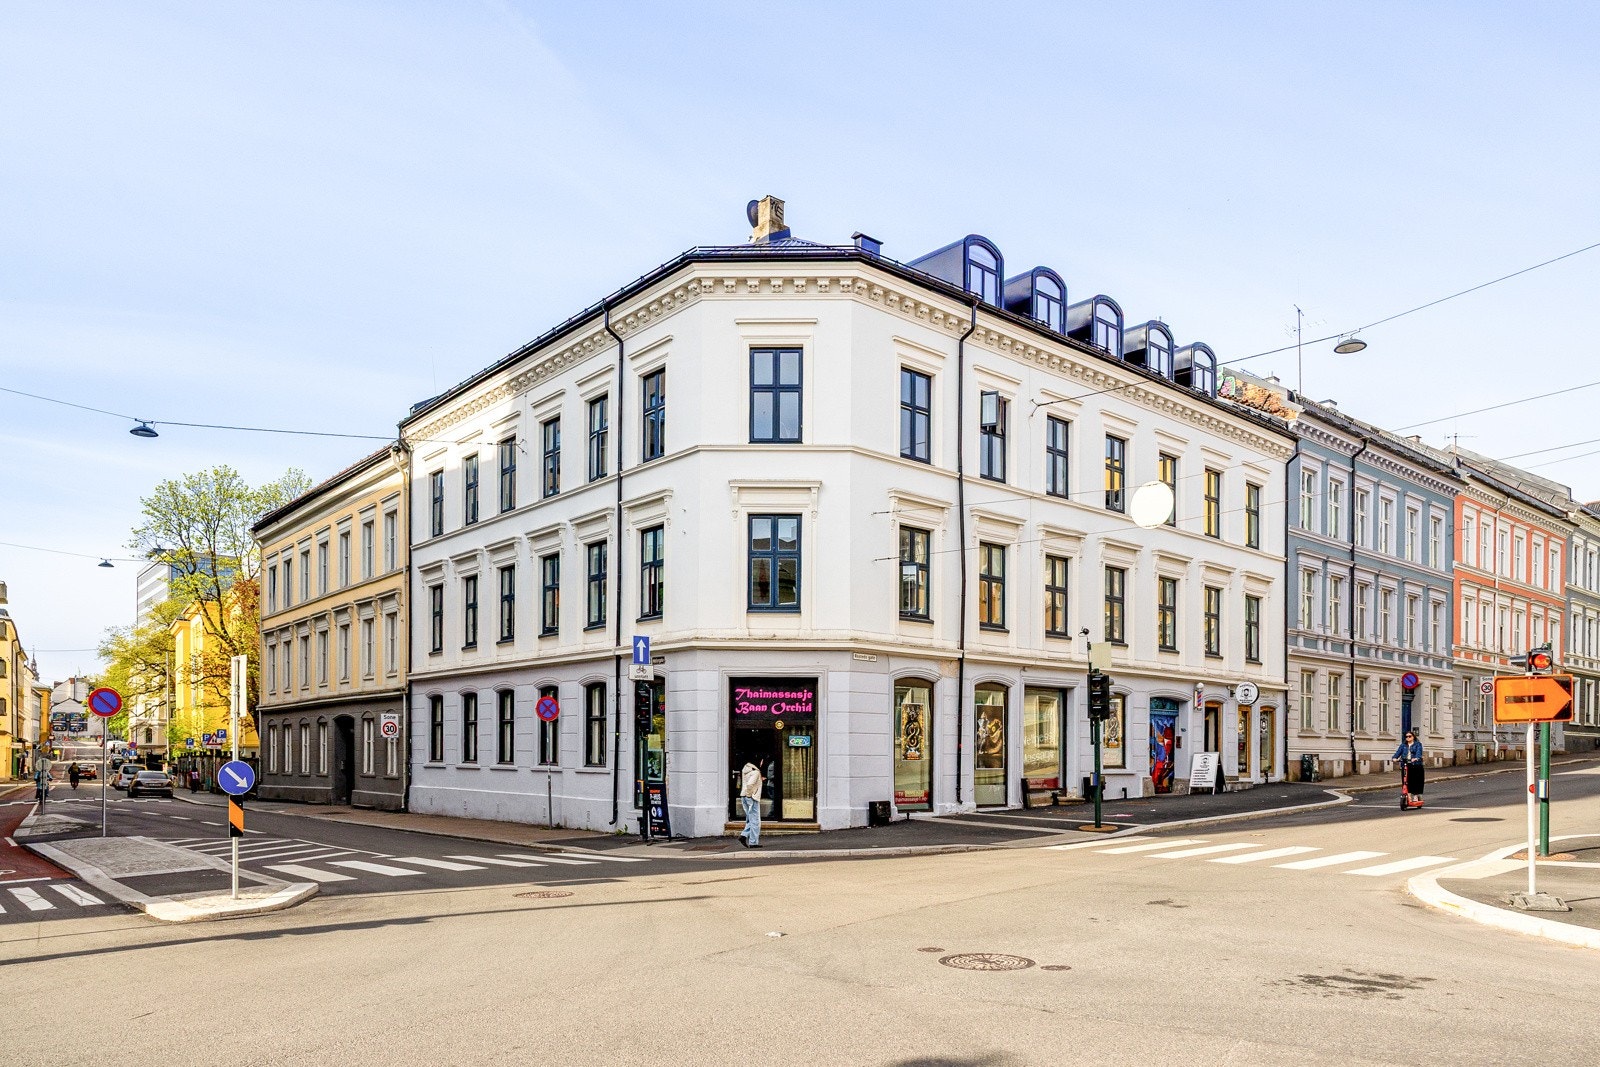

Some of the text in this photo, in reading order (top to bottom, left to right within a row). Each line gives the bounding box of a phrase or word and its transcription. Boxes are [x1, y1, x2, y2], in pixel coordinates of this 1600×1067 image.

[735, 688, 813, 701] Thaimassasje
[735, 701, 813, 715] Baan Orchid
[218, 730, 225, 738] P
[385, 725, 395, 733] 30
